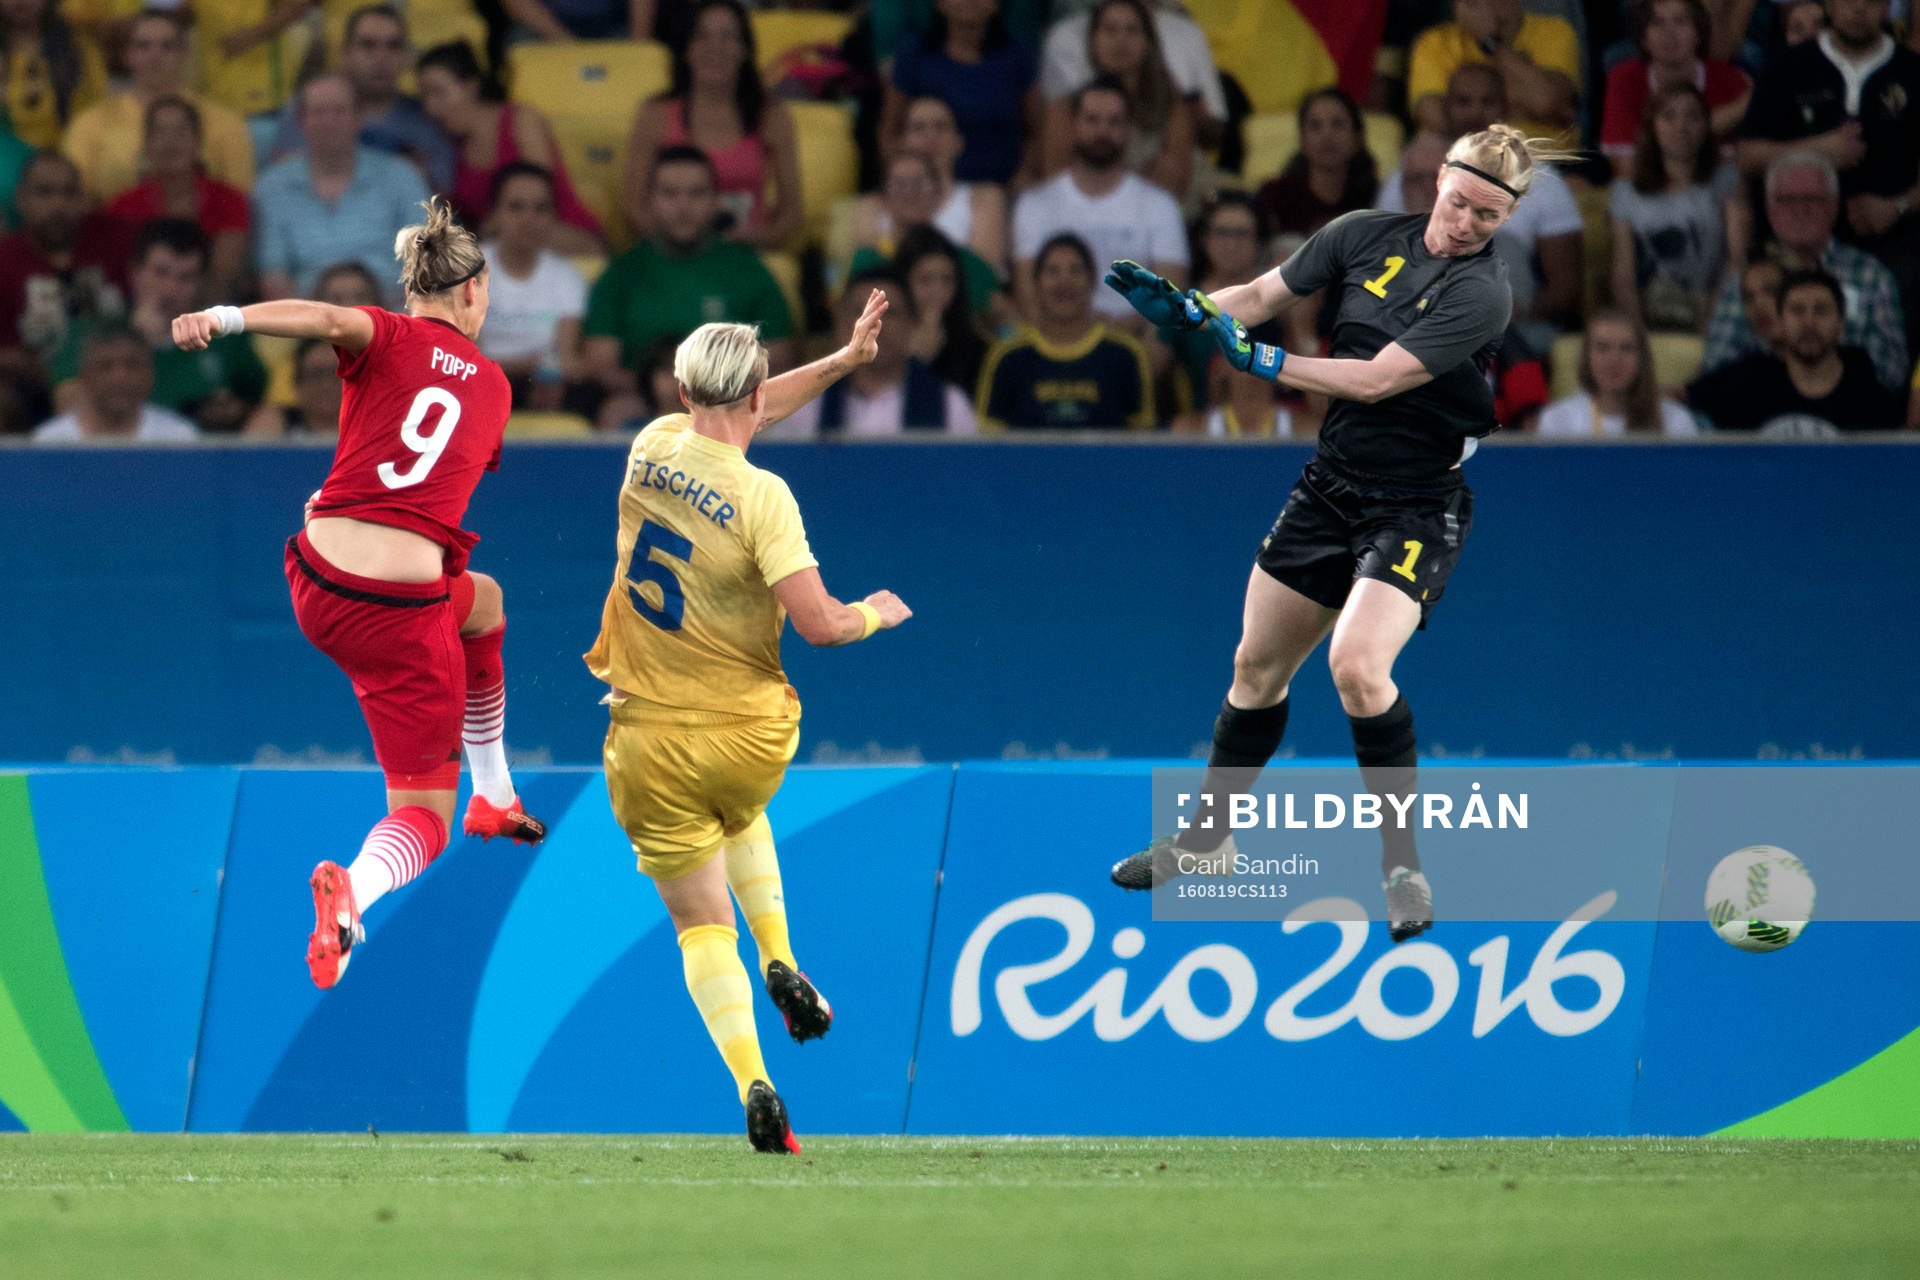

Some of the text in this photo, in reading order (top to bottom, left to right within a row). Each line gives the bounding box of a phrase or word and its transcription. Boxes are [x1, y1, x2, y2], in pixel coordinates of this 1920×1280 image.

[1363, 255, 1406, 299] 1
[431, 346, 478, 382] POPP
[377, 386, 462, 490] 9
[629, 458, 736, 530] FISCHER
[625, 518, 696, 632] 5
[1390, 540, 1424, 583] 1
